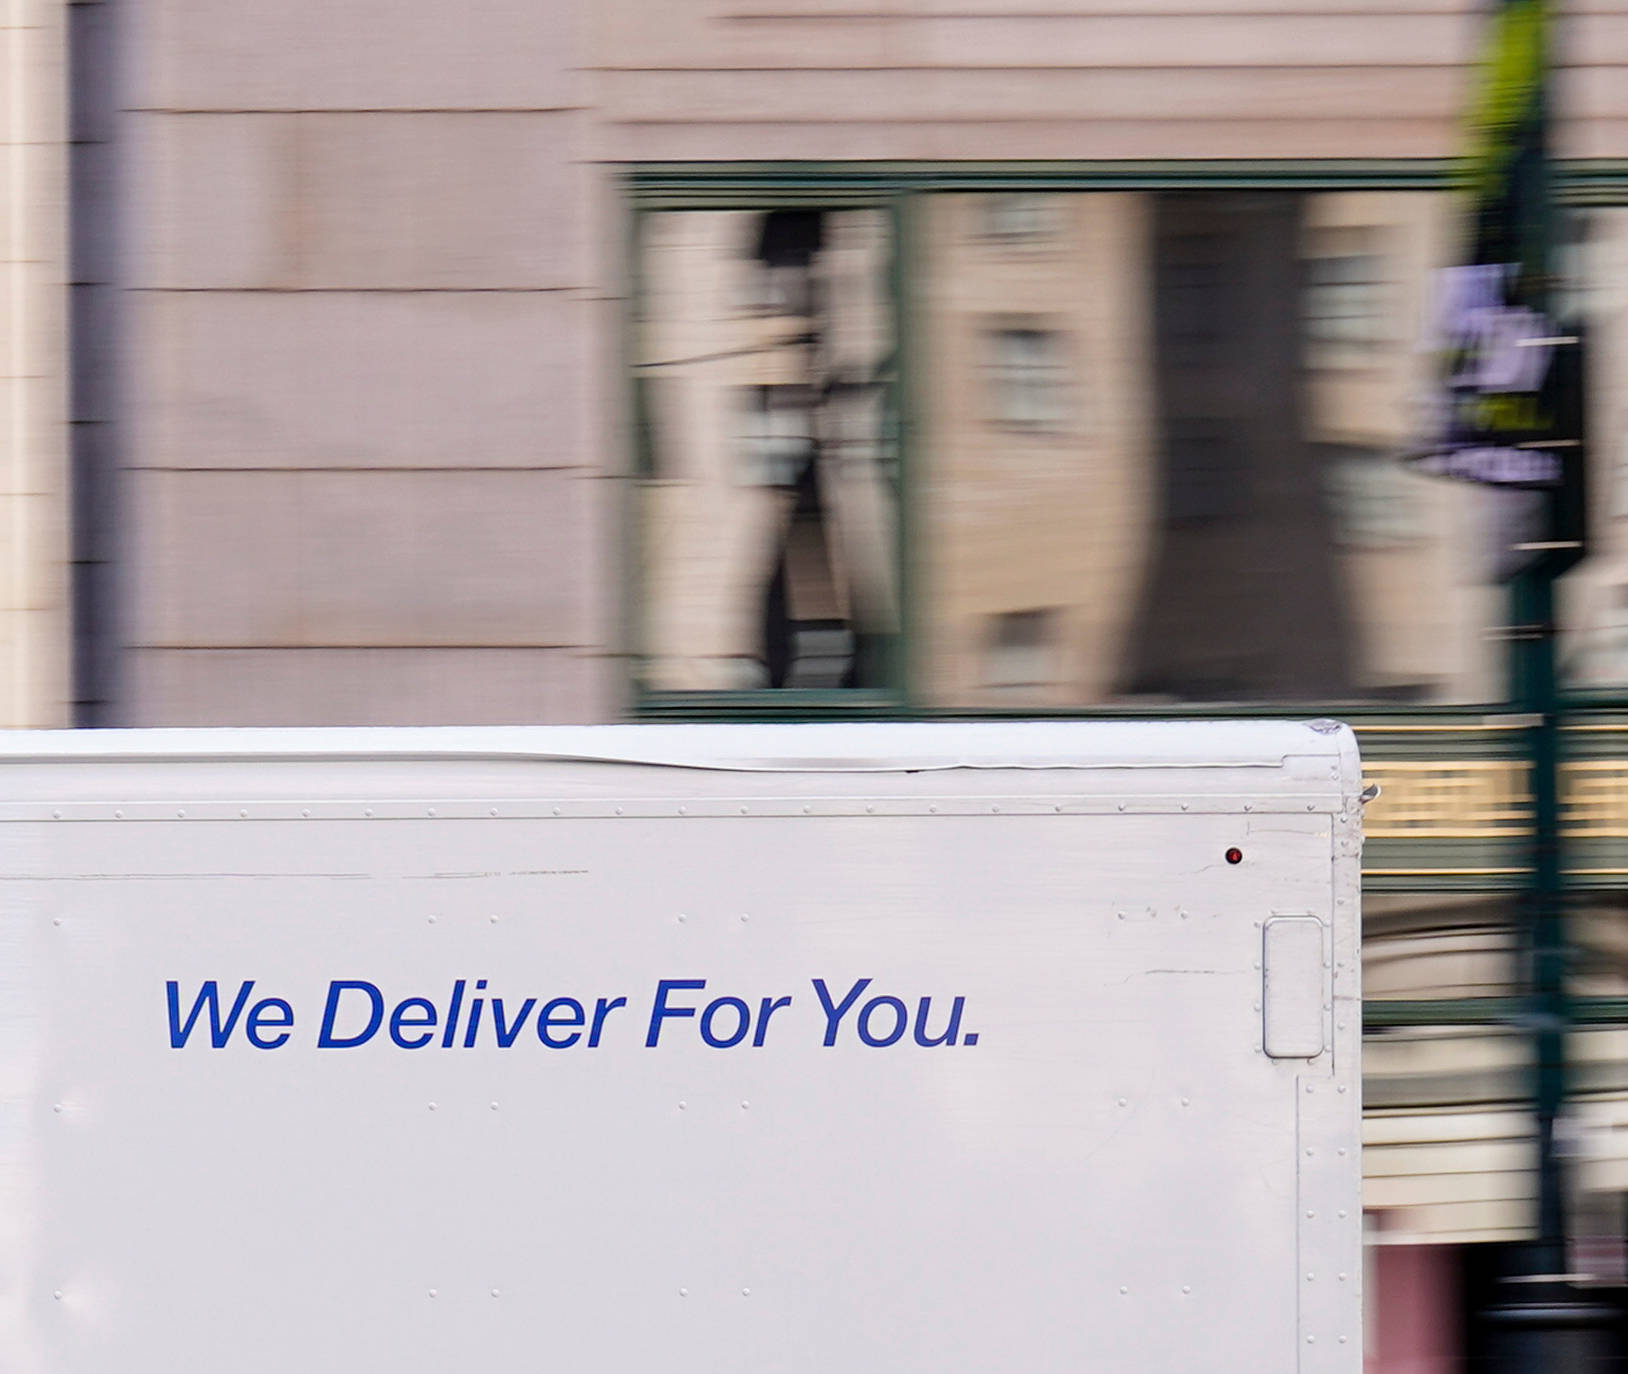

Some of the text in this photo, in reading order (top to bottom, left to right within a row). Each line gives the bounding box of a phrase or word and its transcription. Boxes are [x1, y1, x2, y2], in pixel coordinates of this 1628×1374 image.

[165, 977, 981, 1051] We Deliver For You.
